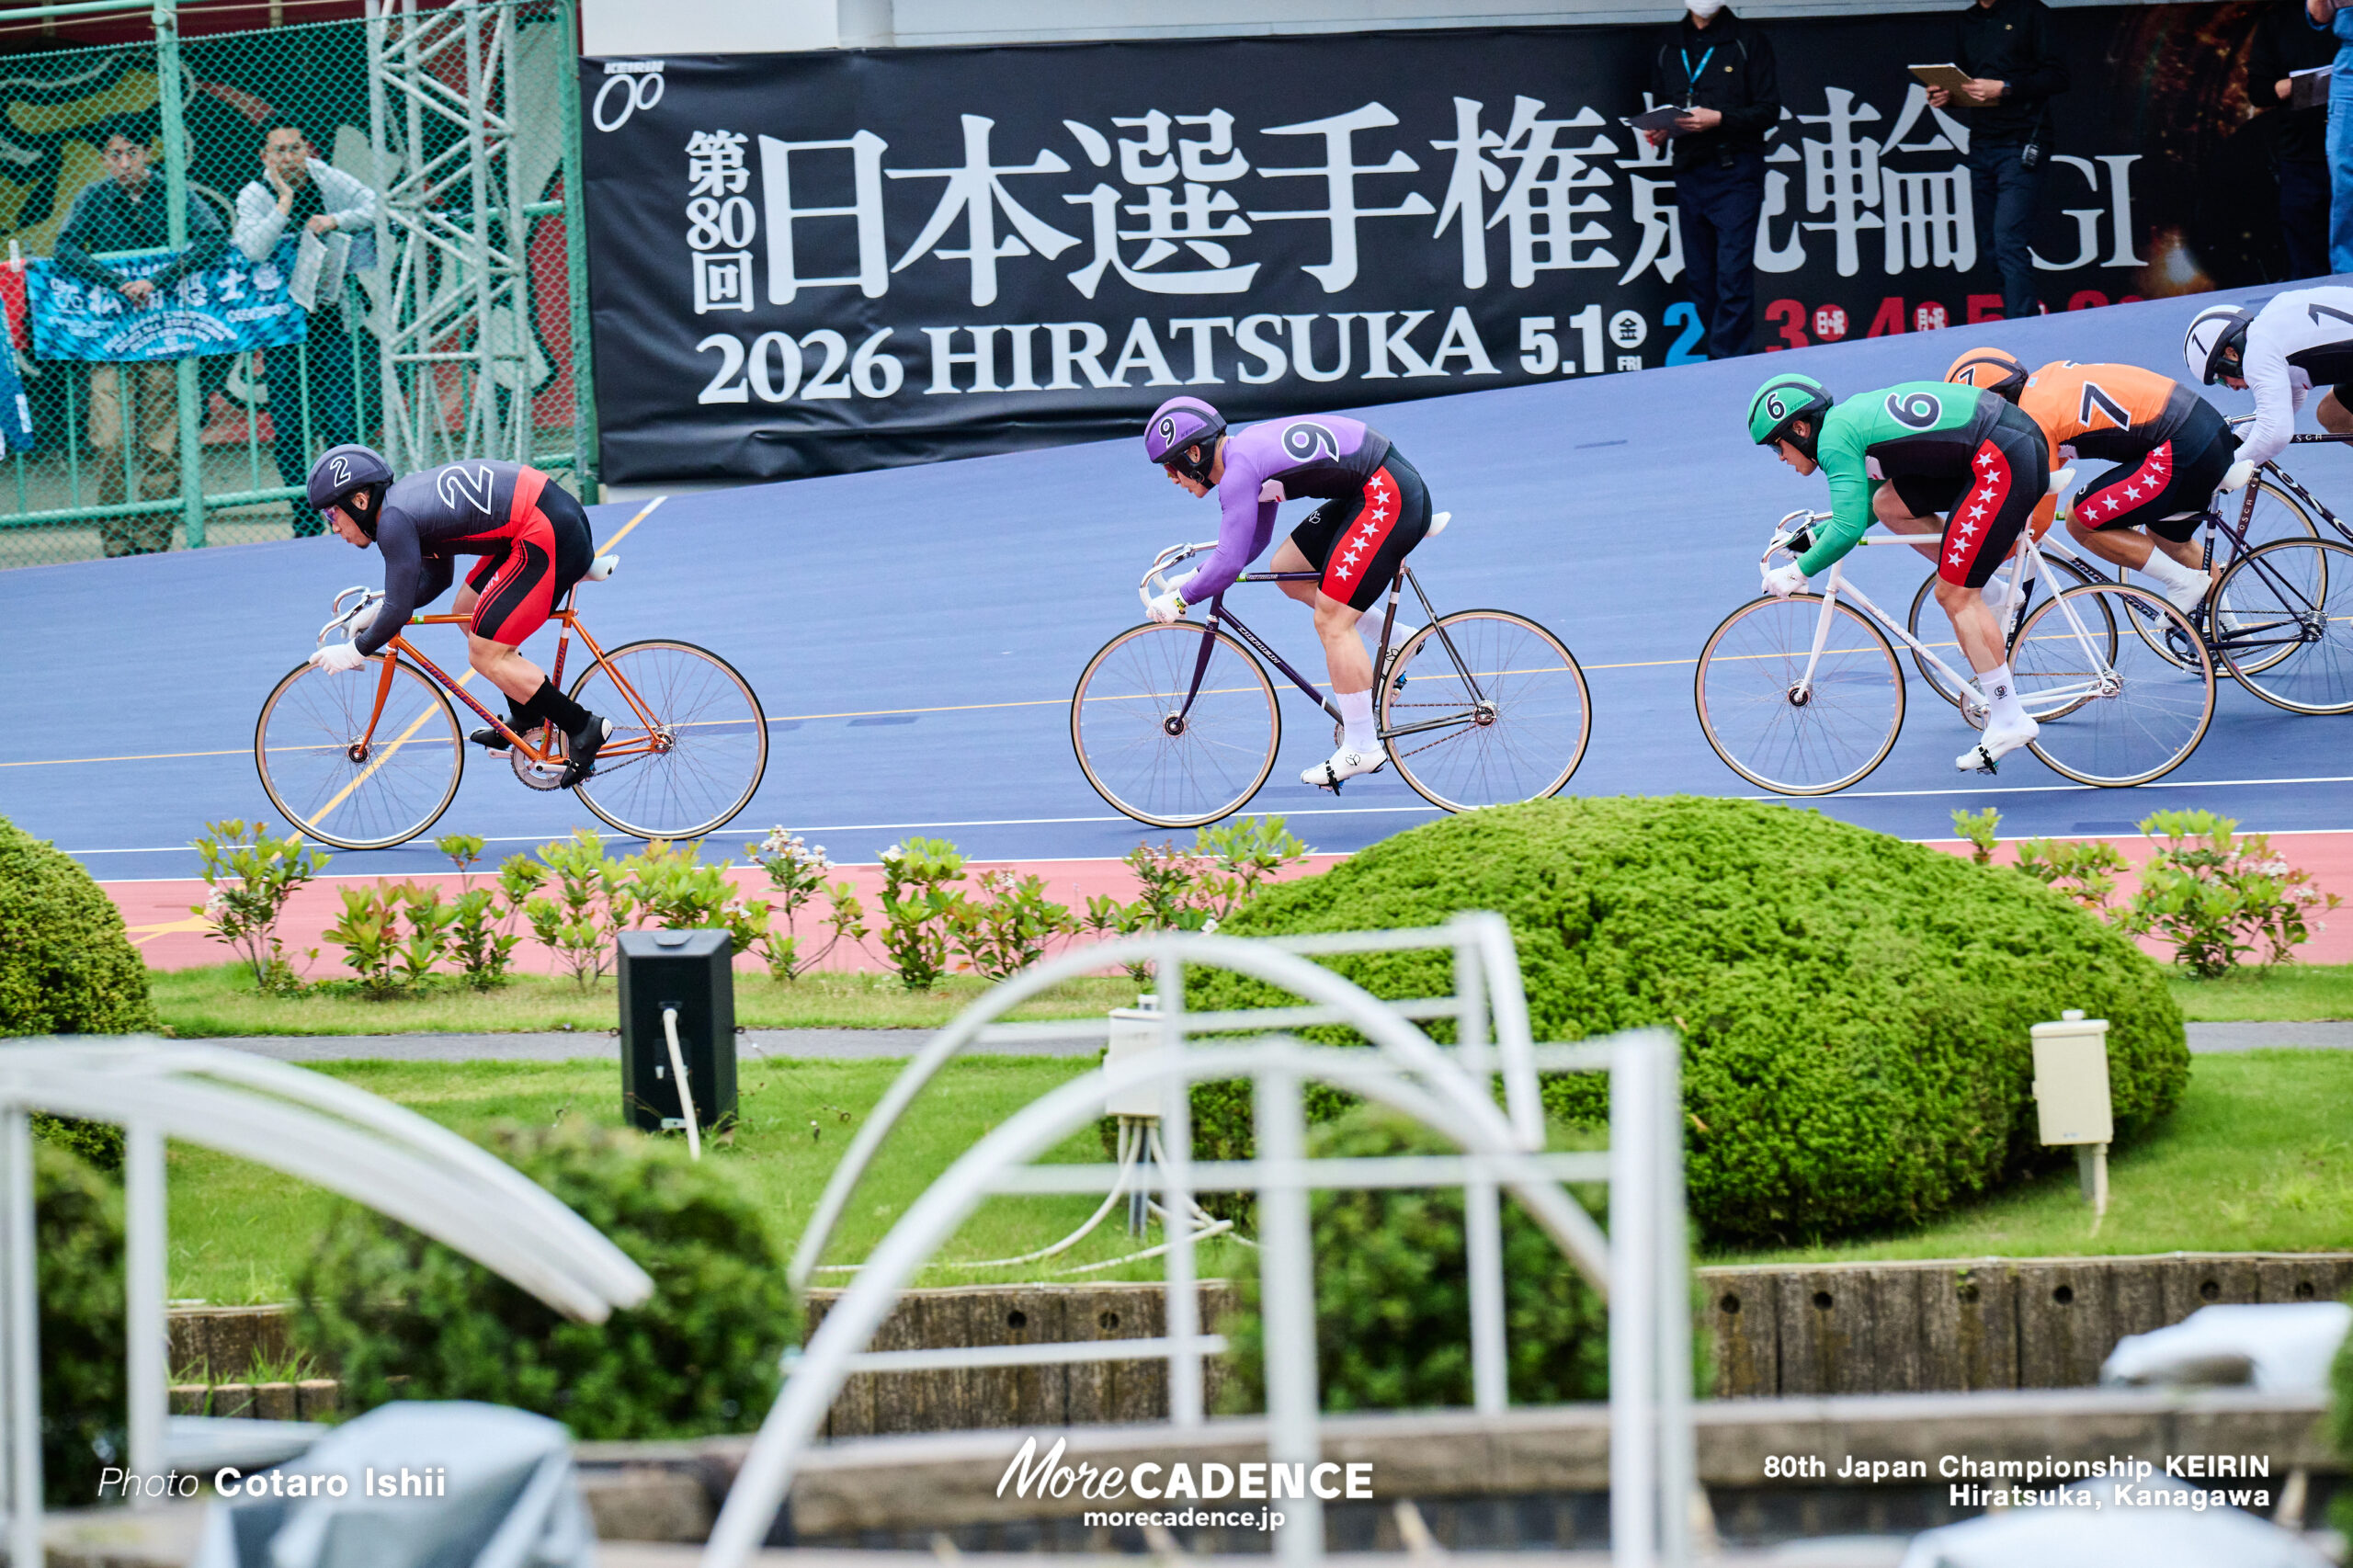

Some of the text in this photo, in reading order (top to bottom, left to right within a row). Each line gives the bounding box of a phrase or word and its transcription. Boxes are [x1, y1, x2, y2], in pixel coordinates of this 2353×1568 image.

[685, 130, 756, 313] 第80回
[697, 326, 904, 404] 2026
[920, 305, 1502, 395] HIRATSUKA
[1519, 304, 1605, 375] 5.1
[1663, 301, 1710, 368] 2
[1617, 356, 1643, 371] FRI
[2192, 333, 2207, 356] 1
[1766, 392, 1786, 421] 6
[1884, 392, 1942, 431] 6
[2078, 381, 2131, 432] 7
[1158, 416, 1176, 449] 9
[1281, 422, 1339, 462] 9
[330, 457, 351, 487] 2
[437, 465, 494, 515] 2
